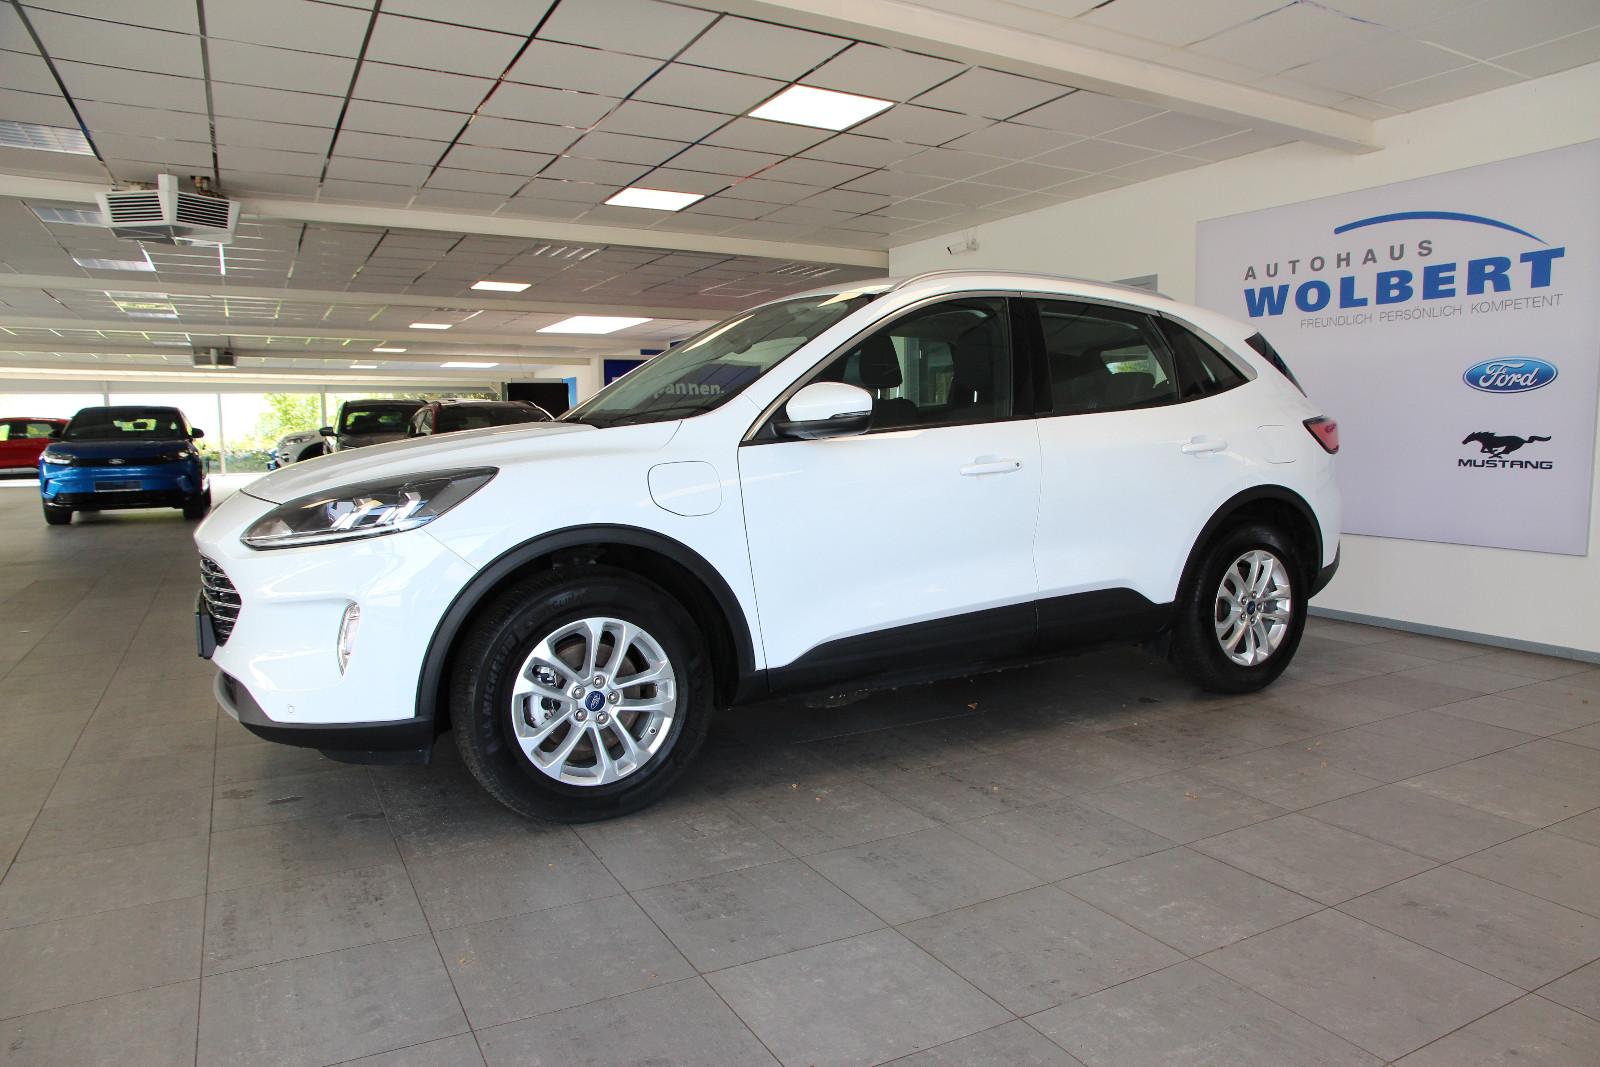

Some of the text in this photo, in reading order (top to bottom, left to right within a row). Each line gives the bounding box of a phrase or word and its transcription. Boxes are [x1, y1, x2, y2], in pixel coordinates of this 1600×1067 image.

[1244, 239, 1433, 280] AUTOHAUS
[1244, 247, 1566, 317] WOLBERT
[1300, 293, 1564, 329] FREUNDLICH PERSÖNLICH KOMPETENT
[1479, 363, 1539, 387] Ford
[1458, 459, 1553, 470] MUSTANG
